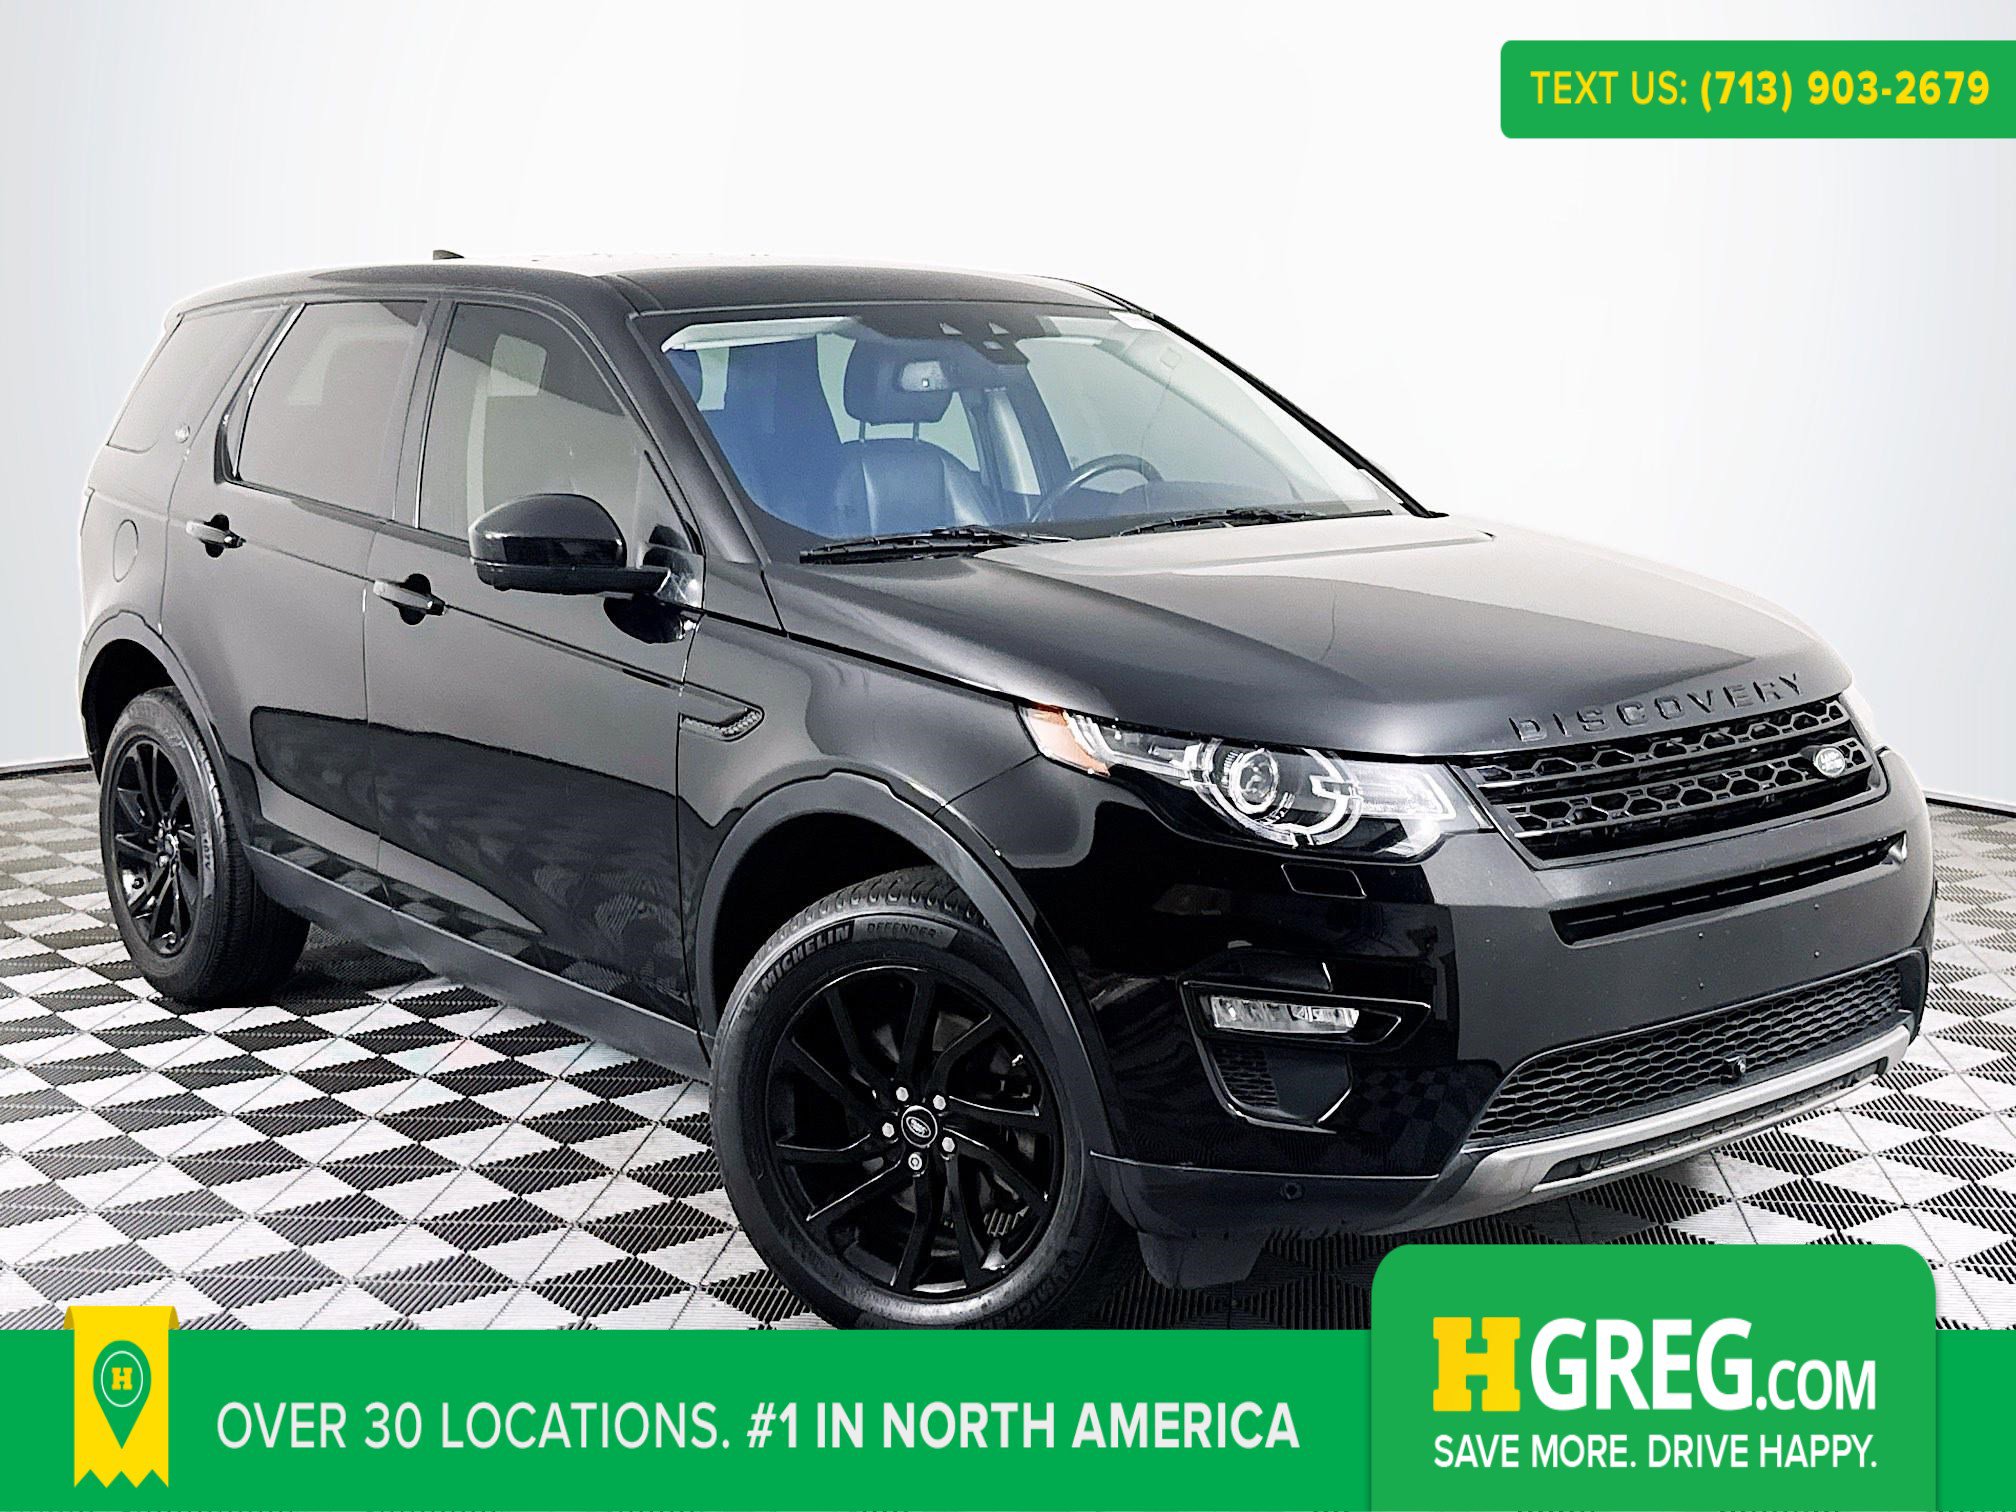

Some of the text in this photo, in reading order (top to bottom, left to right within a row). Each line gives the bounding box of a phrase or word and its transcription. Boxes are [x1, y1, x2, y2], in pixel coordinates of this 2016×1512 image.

[1508, 672, 1803, 742] DISCOVERY
[761, 922, 938, 993] MICHELIN DEFENDER
